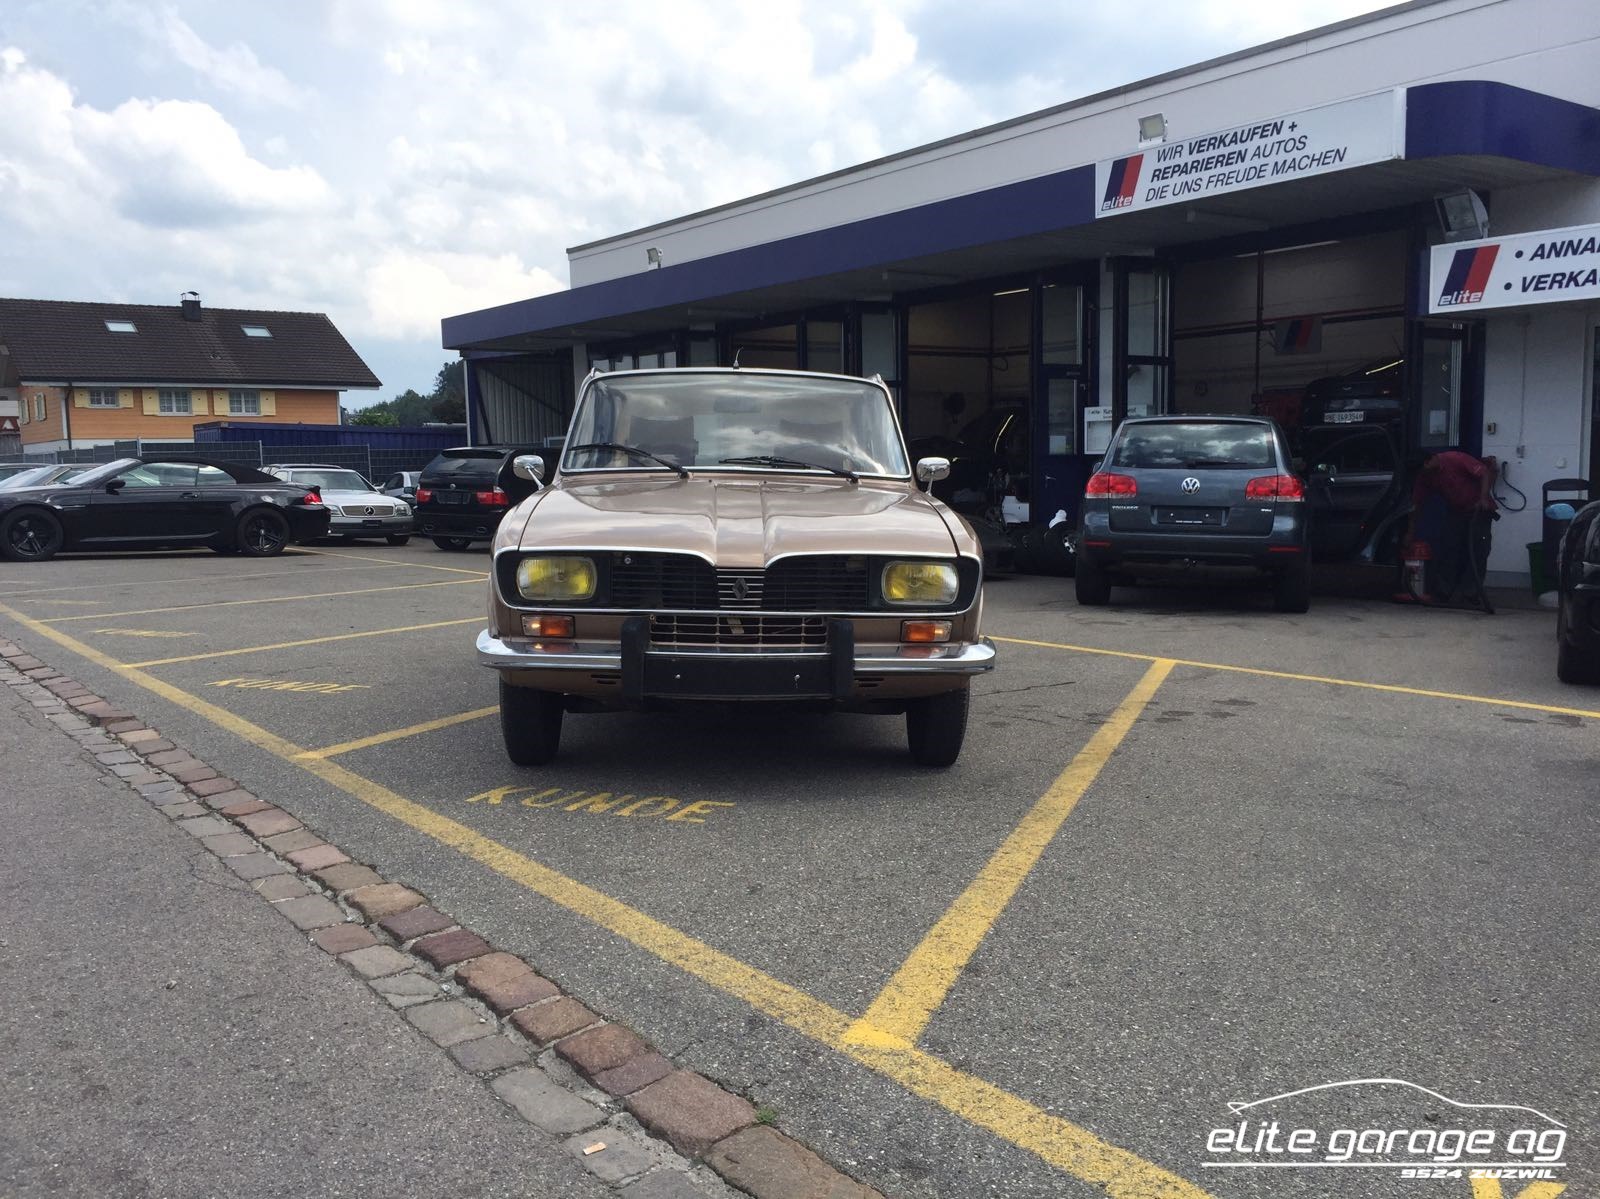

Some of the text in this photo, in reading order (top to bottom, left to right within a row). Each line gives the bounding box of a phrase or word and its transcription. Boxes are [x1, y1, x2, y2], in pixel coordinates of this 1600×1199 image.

[1151, 135, 1308, 183] REPARIEREN AUTOS
[1157, 120, 1298, 163] WIR VERKAUFEN +
[1145, 147, 1347, 202] DIE UNS FREUDE MACHEN
[1102, 195, 1133, 211] elite
[1439, 290, 1483, 306] elite
[1521, 268, 1600, 293] VERKA
[465, 785, 736, 824] KUNDE
